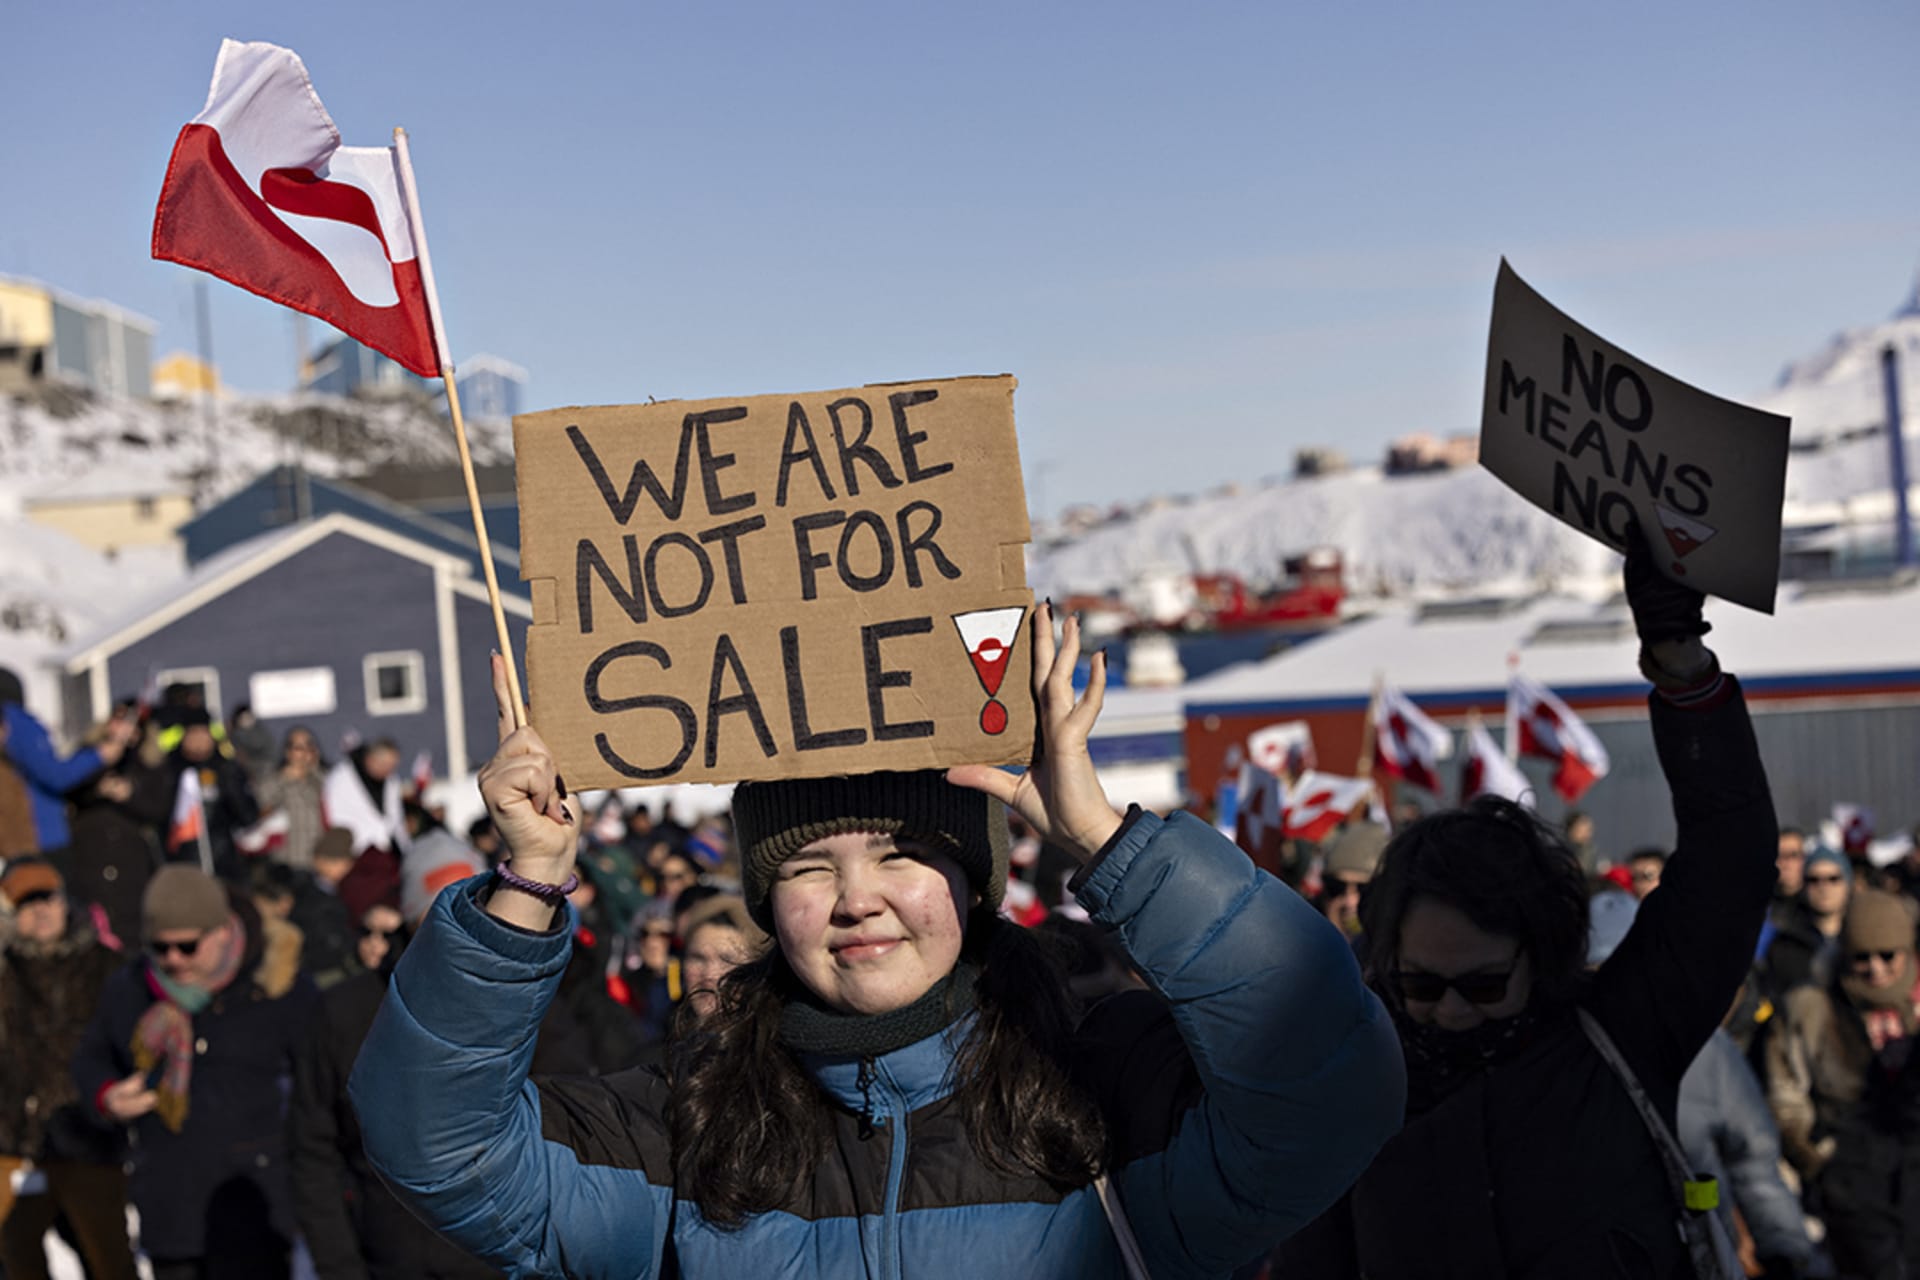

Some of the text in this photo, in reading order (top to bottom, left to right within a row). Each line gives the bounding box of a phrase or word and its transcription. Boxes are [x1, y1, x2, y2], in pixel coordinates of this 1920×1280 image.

[1499, 358, 1713, 517] MEANS
[1561, 332, 1653, 433] NO
[565, 389, 954, 526] WE ARE
[576, 500, 962, 634] NOT FOR
